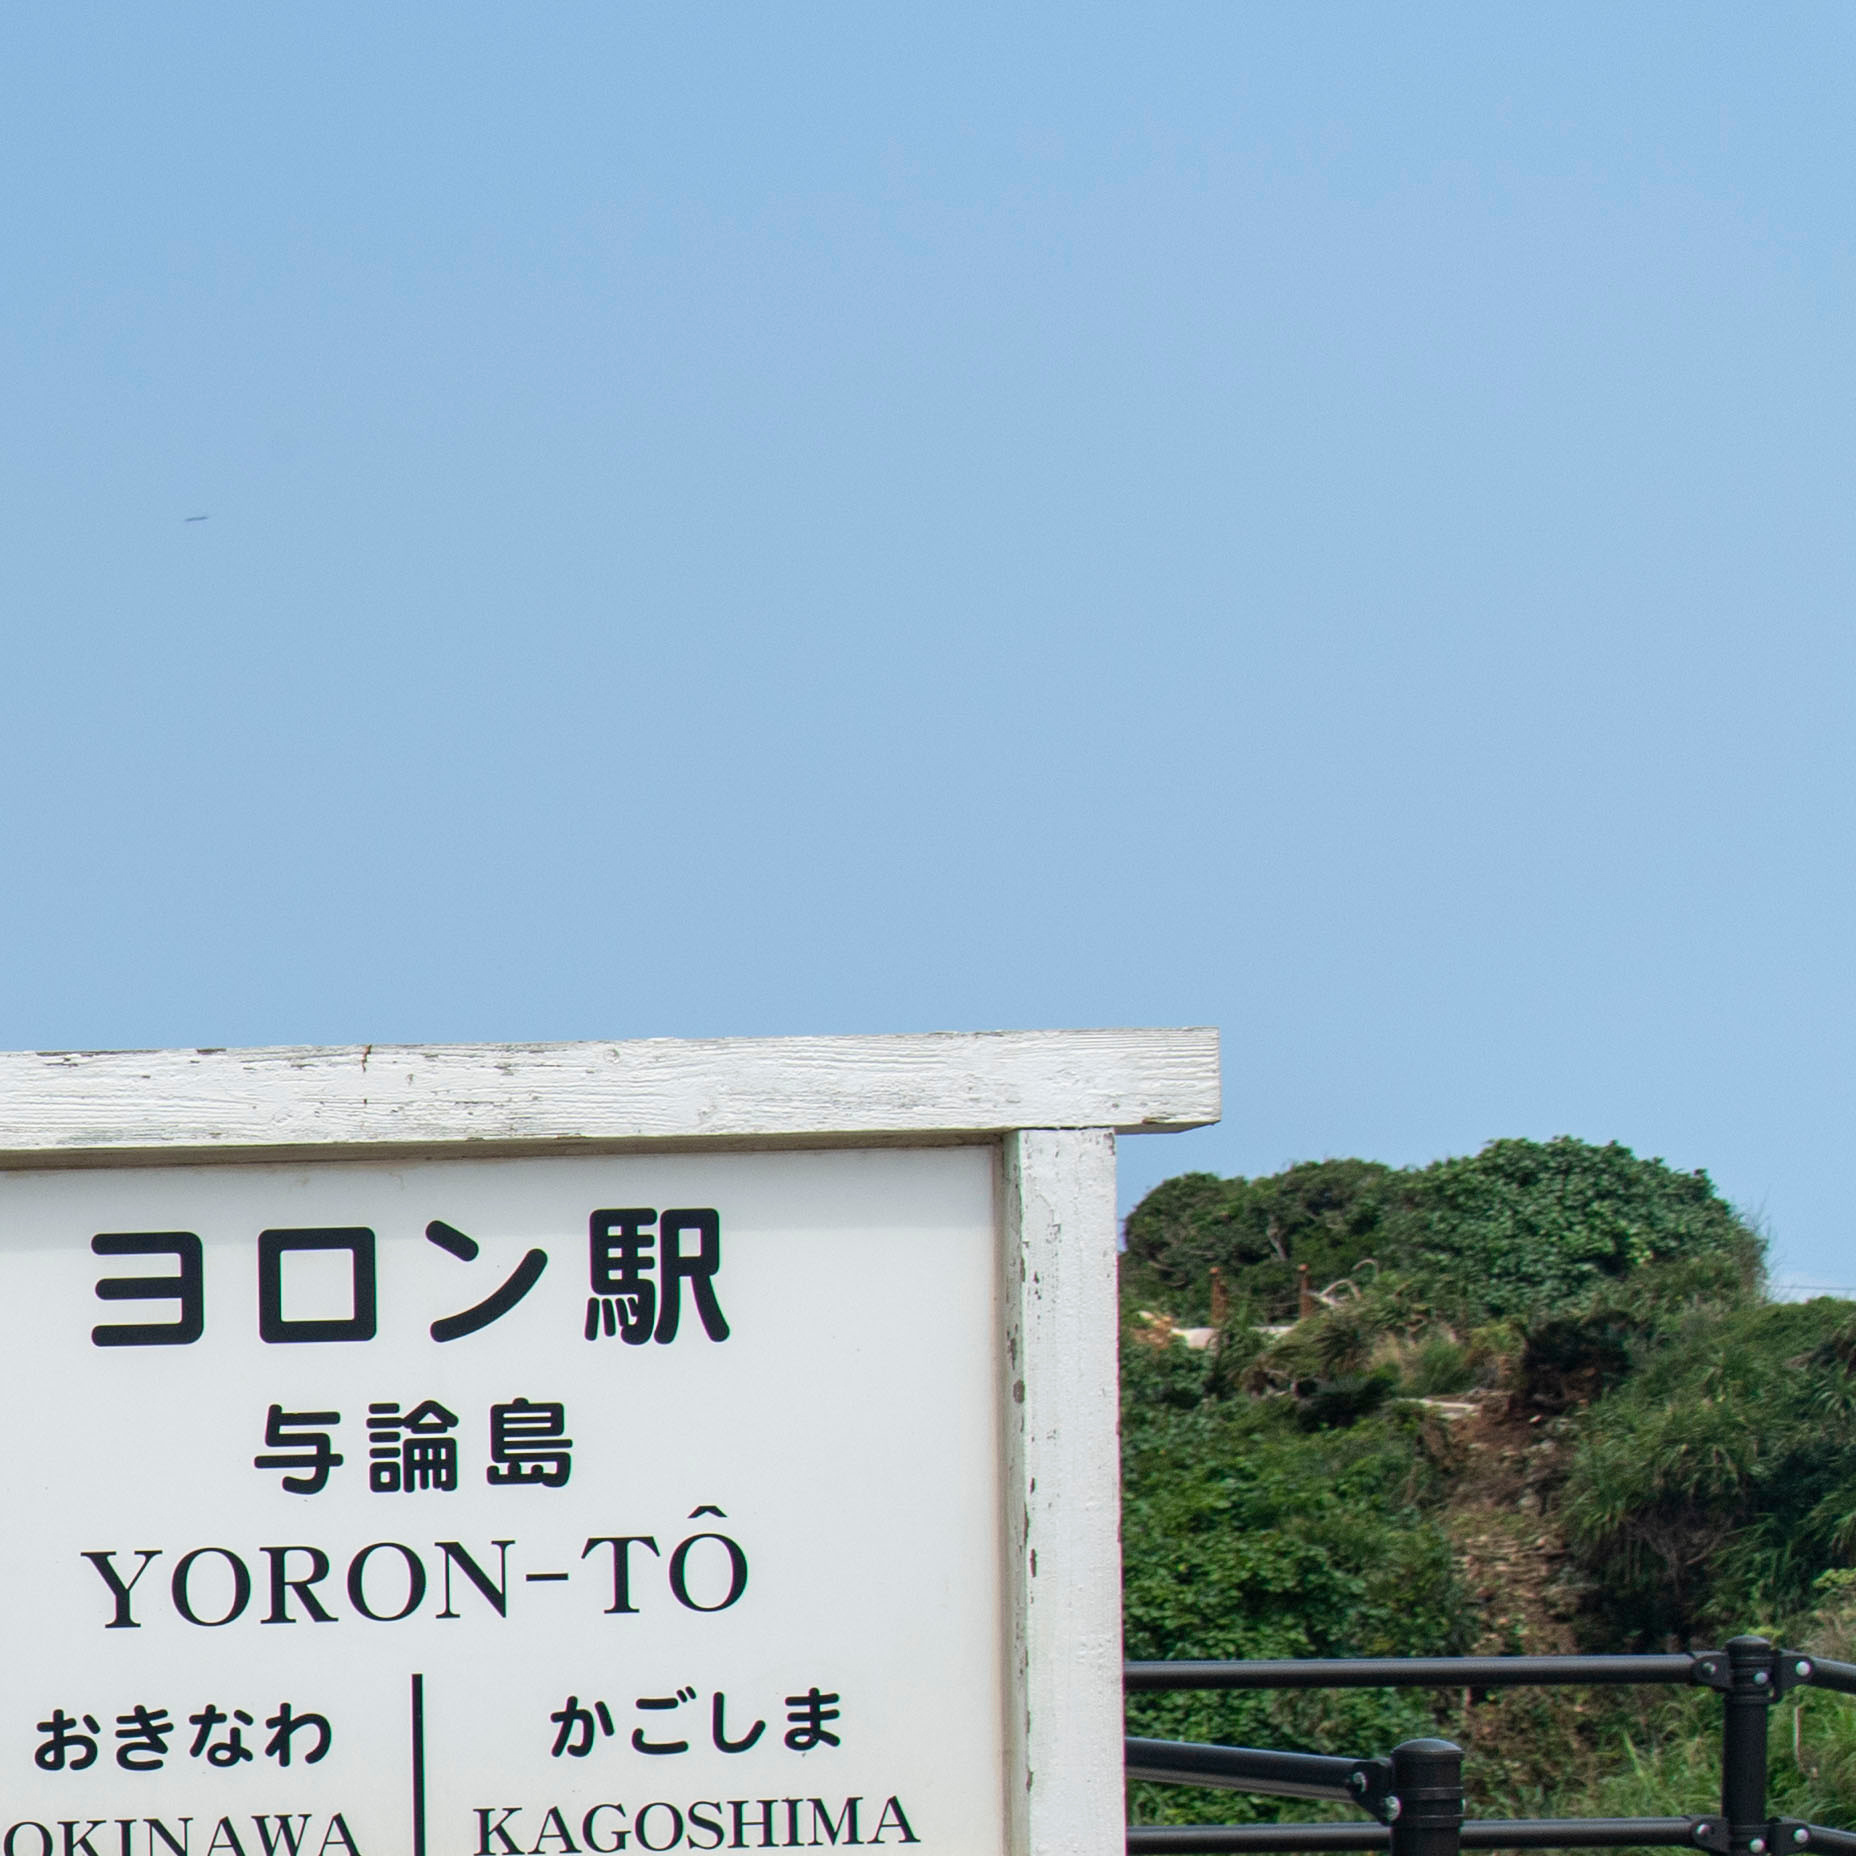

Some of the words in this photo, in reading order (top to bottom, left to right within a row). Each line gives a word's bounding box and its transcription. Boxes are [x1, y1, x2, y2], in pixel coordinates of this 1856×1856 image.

[91, 1208, 729, 1346] ヨロン駅
[255, 1398, 572, 1494] 与論島
[81, 1506, 748, 1629] YORON-TÔ
[35, 1703, 331, 1771] おきなわ
[551, 1687, 840, 1757] かごしま
[473, 1796, 920, 1856] KAGOSHIMA
